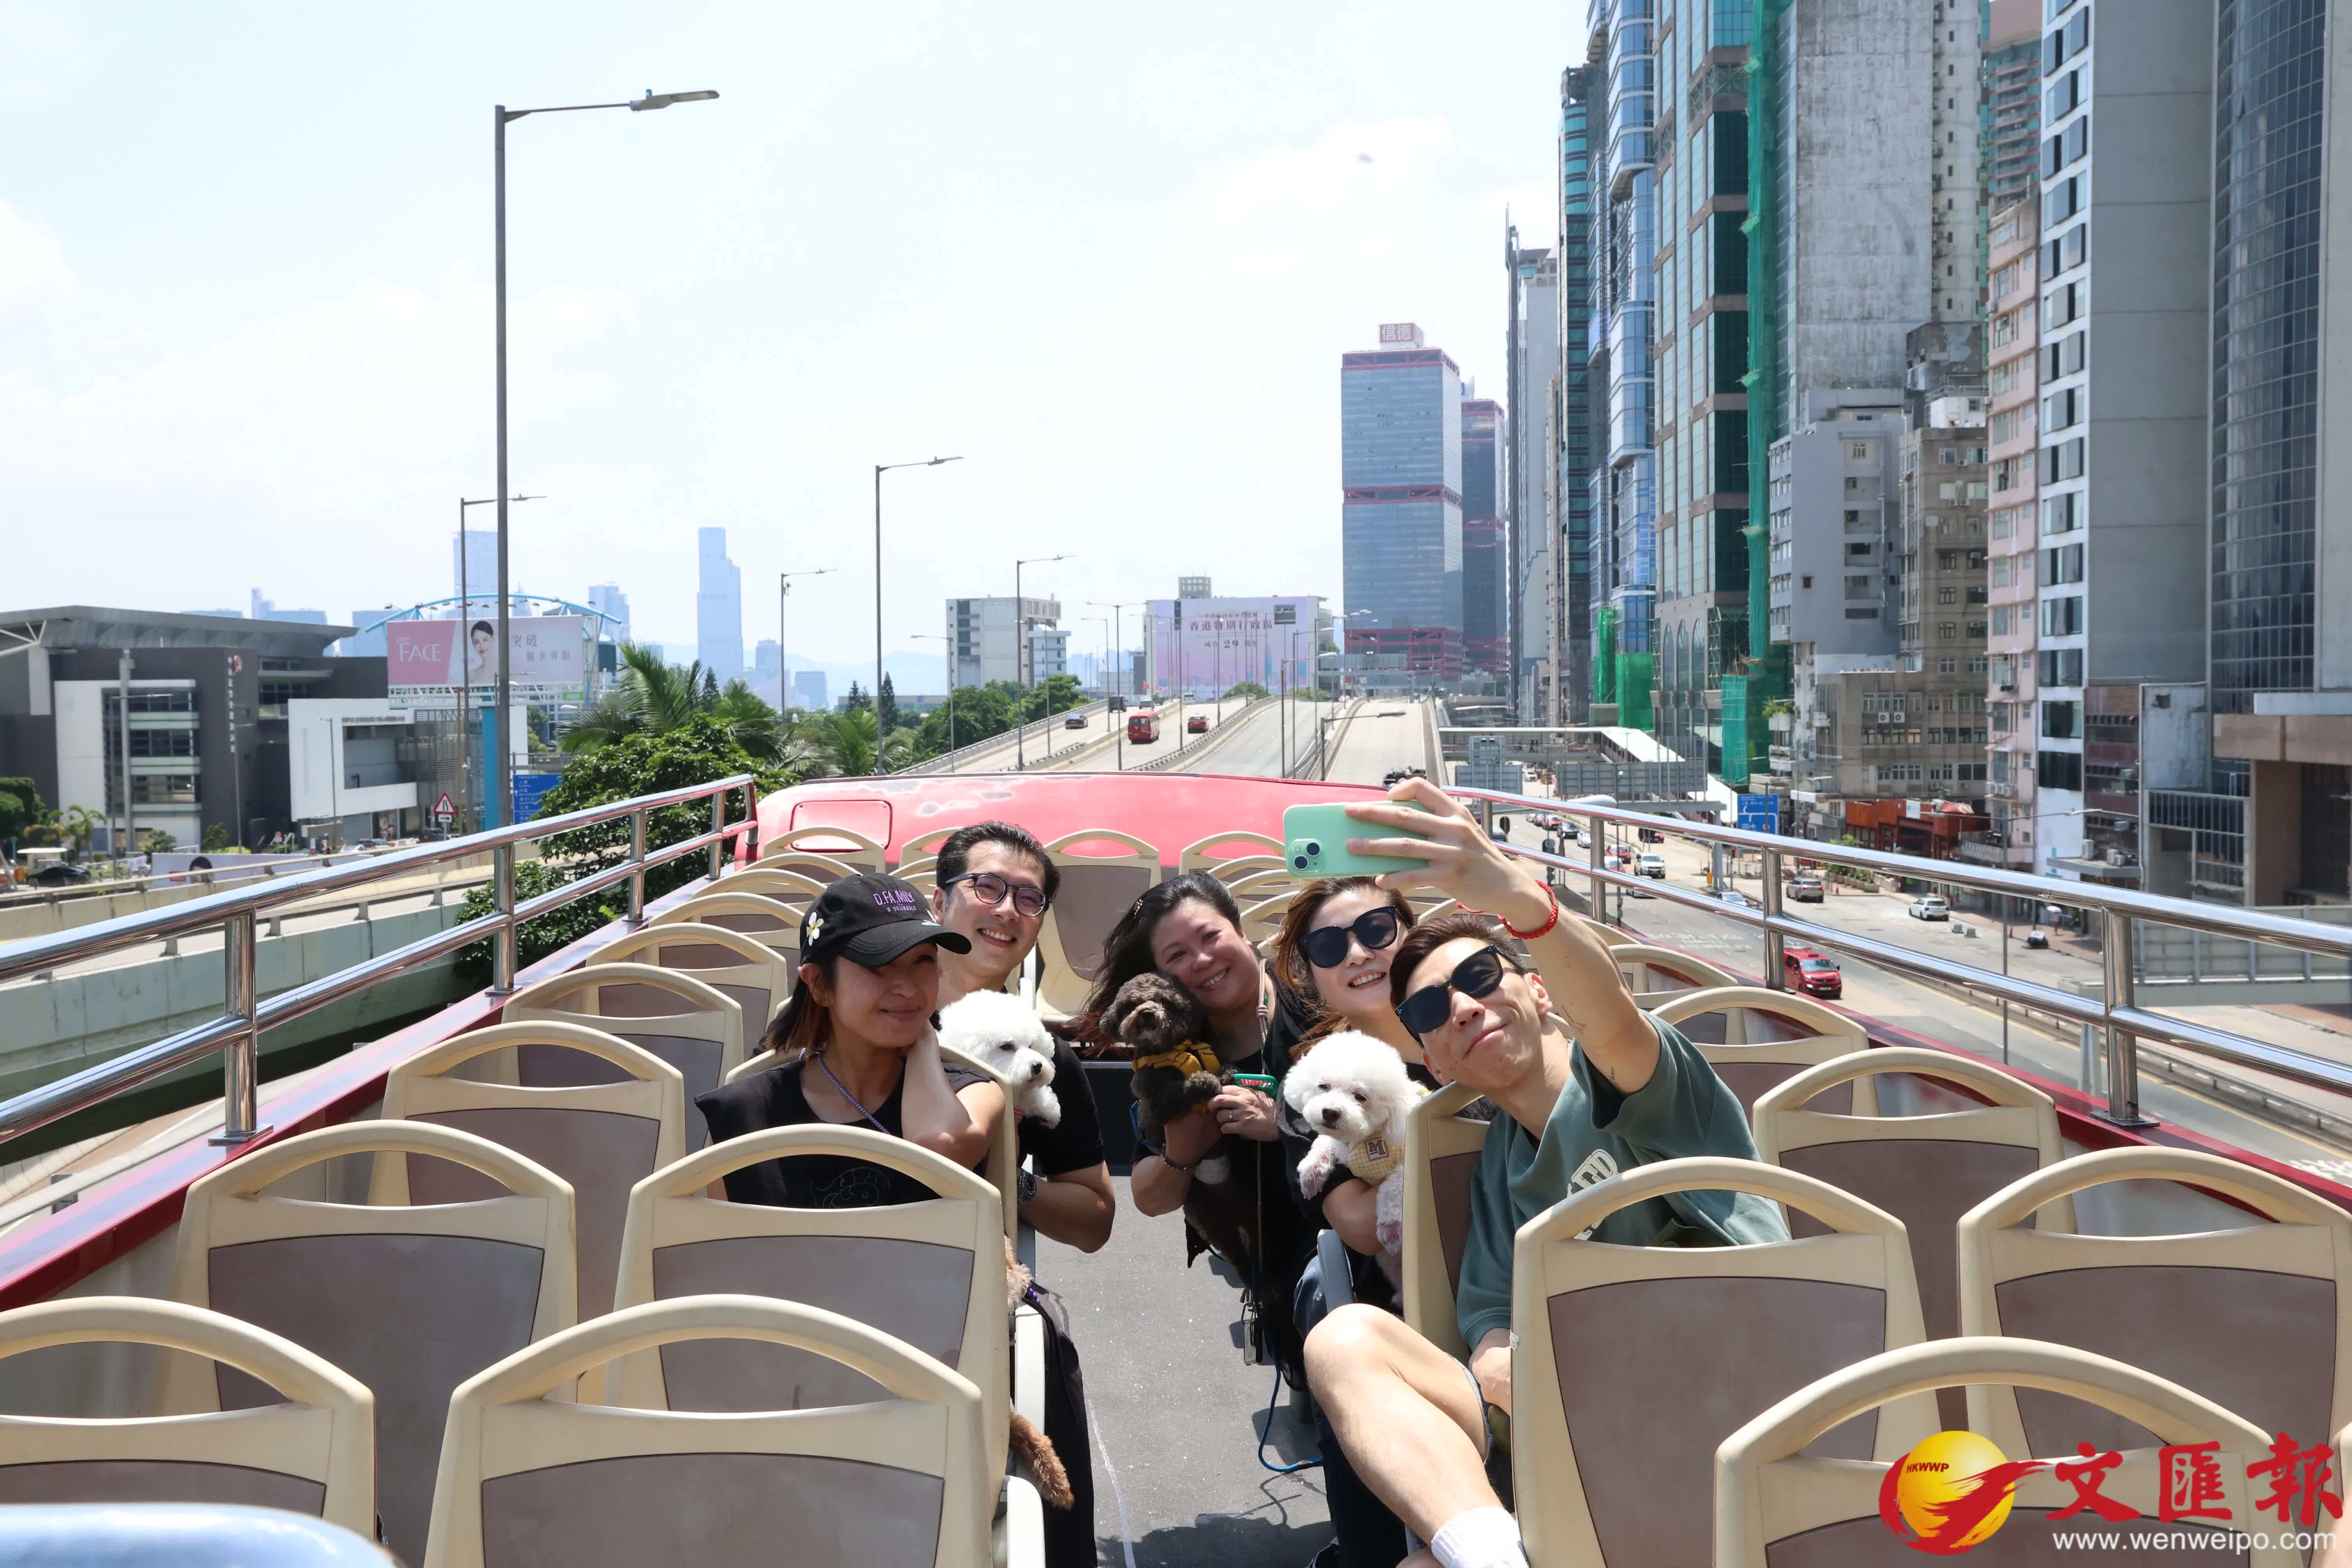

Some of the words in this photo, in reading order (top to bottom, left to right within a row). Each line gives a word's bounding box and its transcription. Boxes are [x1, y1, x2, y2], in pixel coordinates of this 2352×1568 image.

[1382, 323, 1412, 340] 信德
[511, 633, 537, 648] 突破
[1223, 639, 1239, 648] 29
[399, 643, 442, 662] FACE
[1367, 1139, 1386, 1155] M
